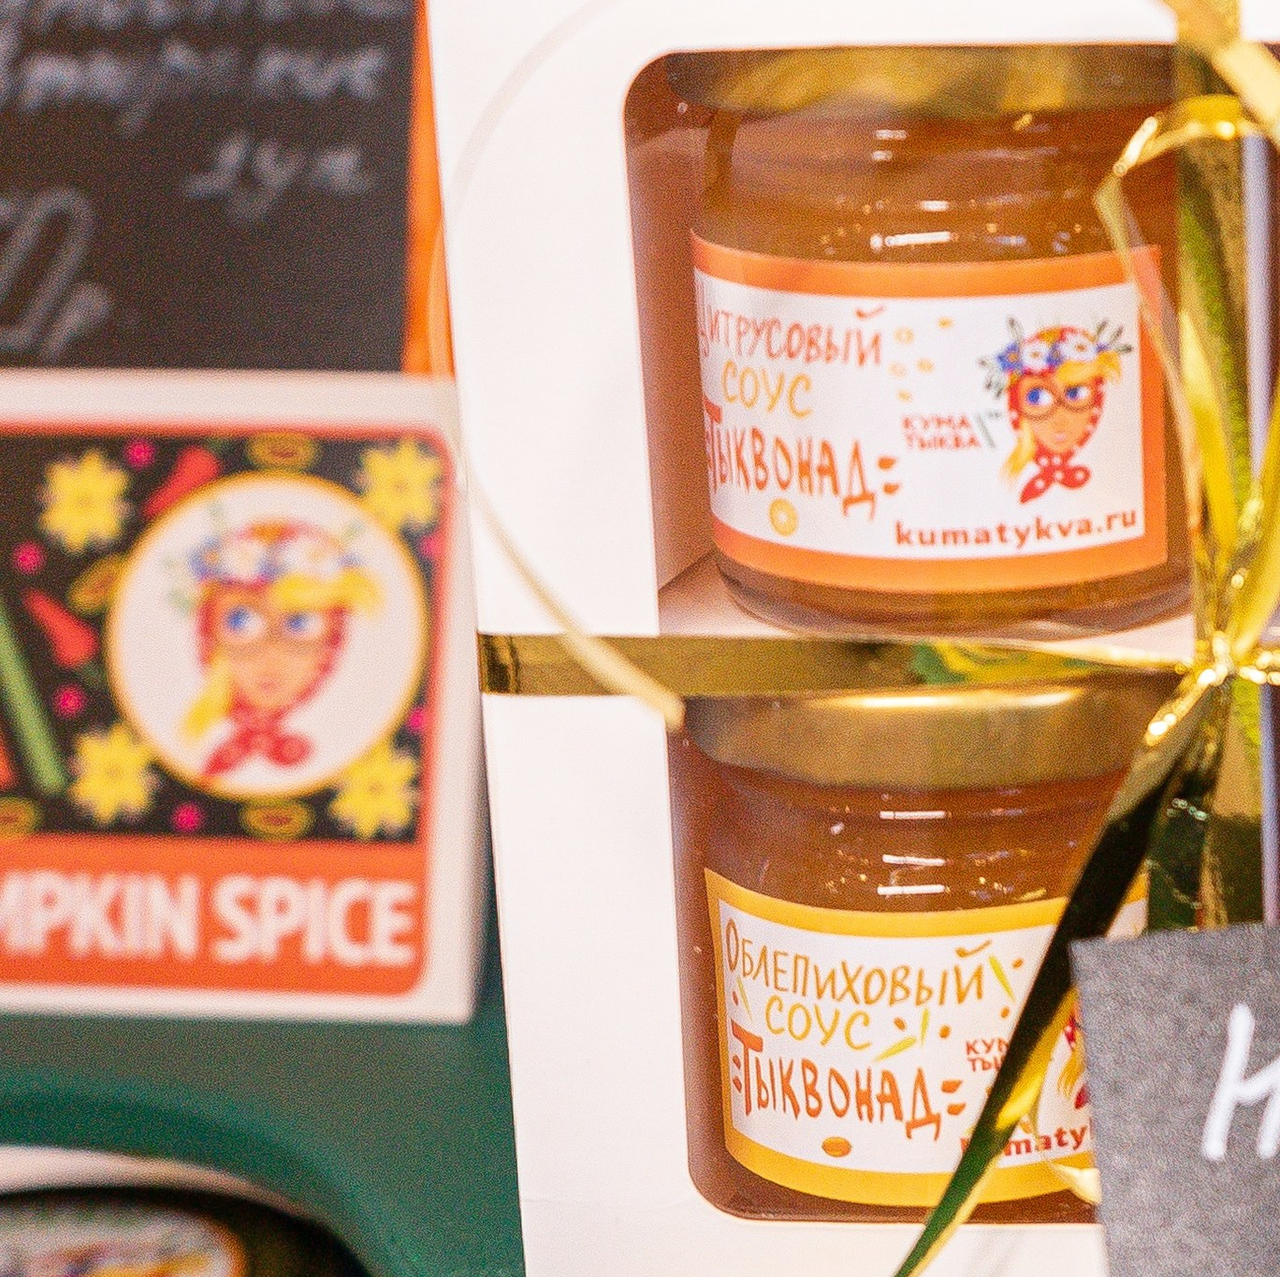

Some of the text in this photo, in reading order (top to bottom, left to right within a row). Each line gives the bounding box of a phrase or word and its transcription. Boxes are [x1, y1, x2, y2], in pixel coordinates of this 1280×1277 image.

[721, 359, 814, 420] СОУС
[895, 505, 1138, 550] kumatykva.ru
[211, 875, 417, 966] SPICE
[764, 994, 873, 1052] СОУС
